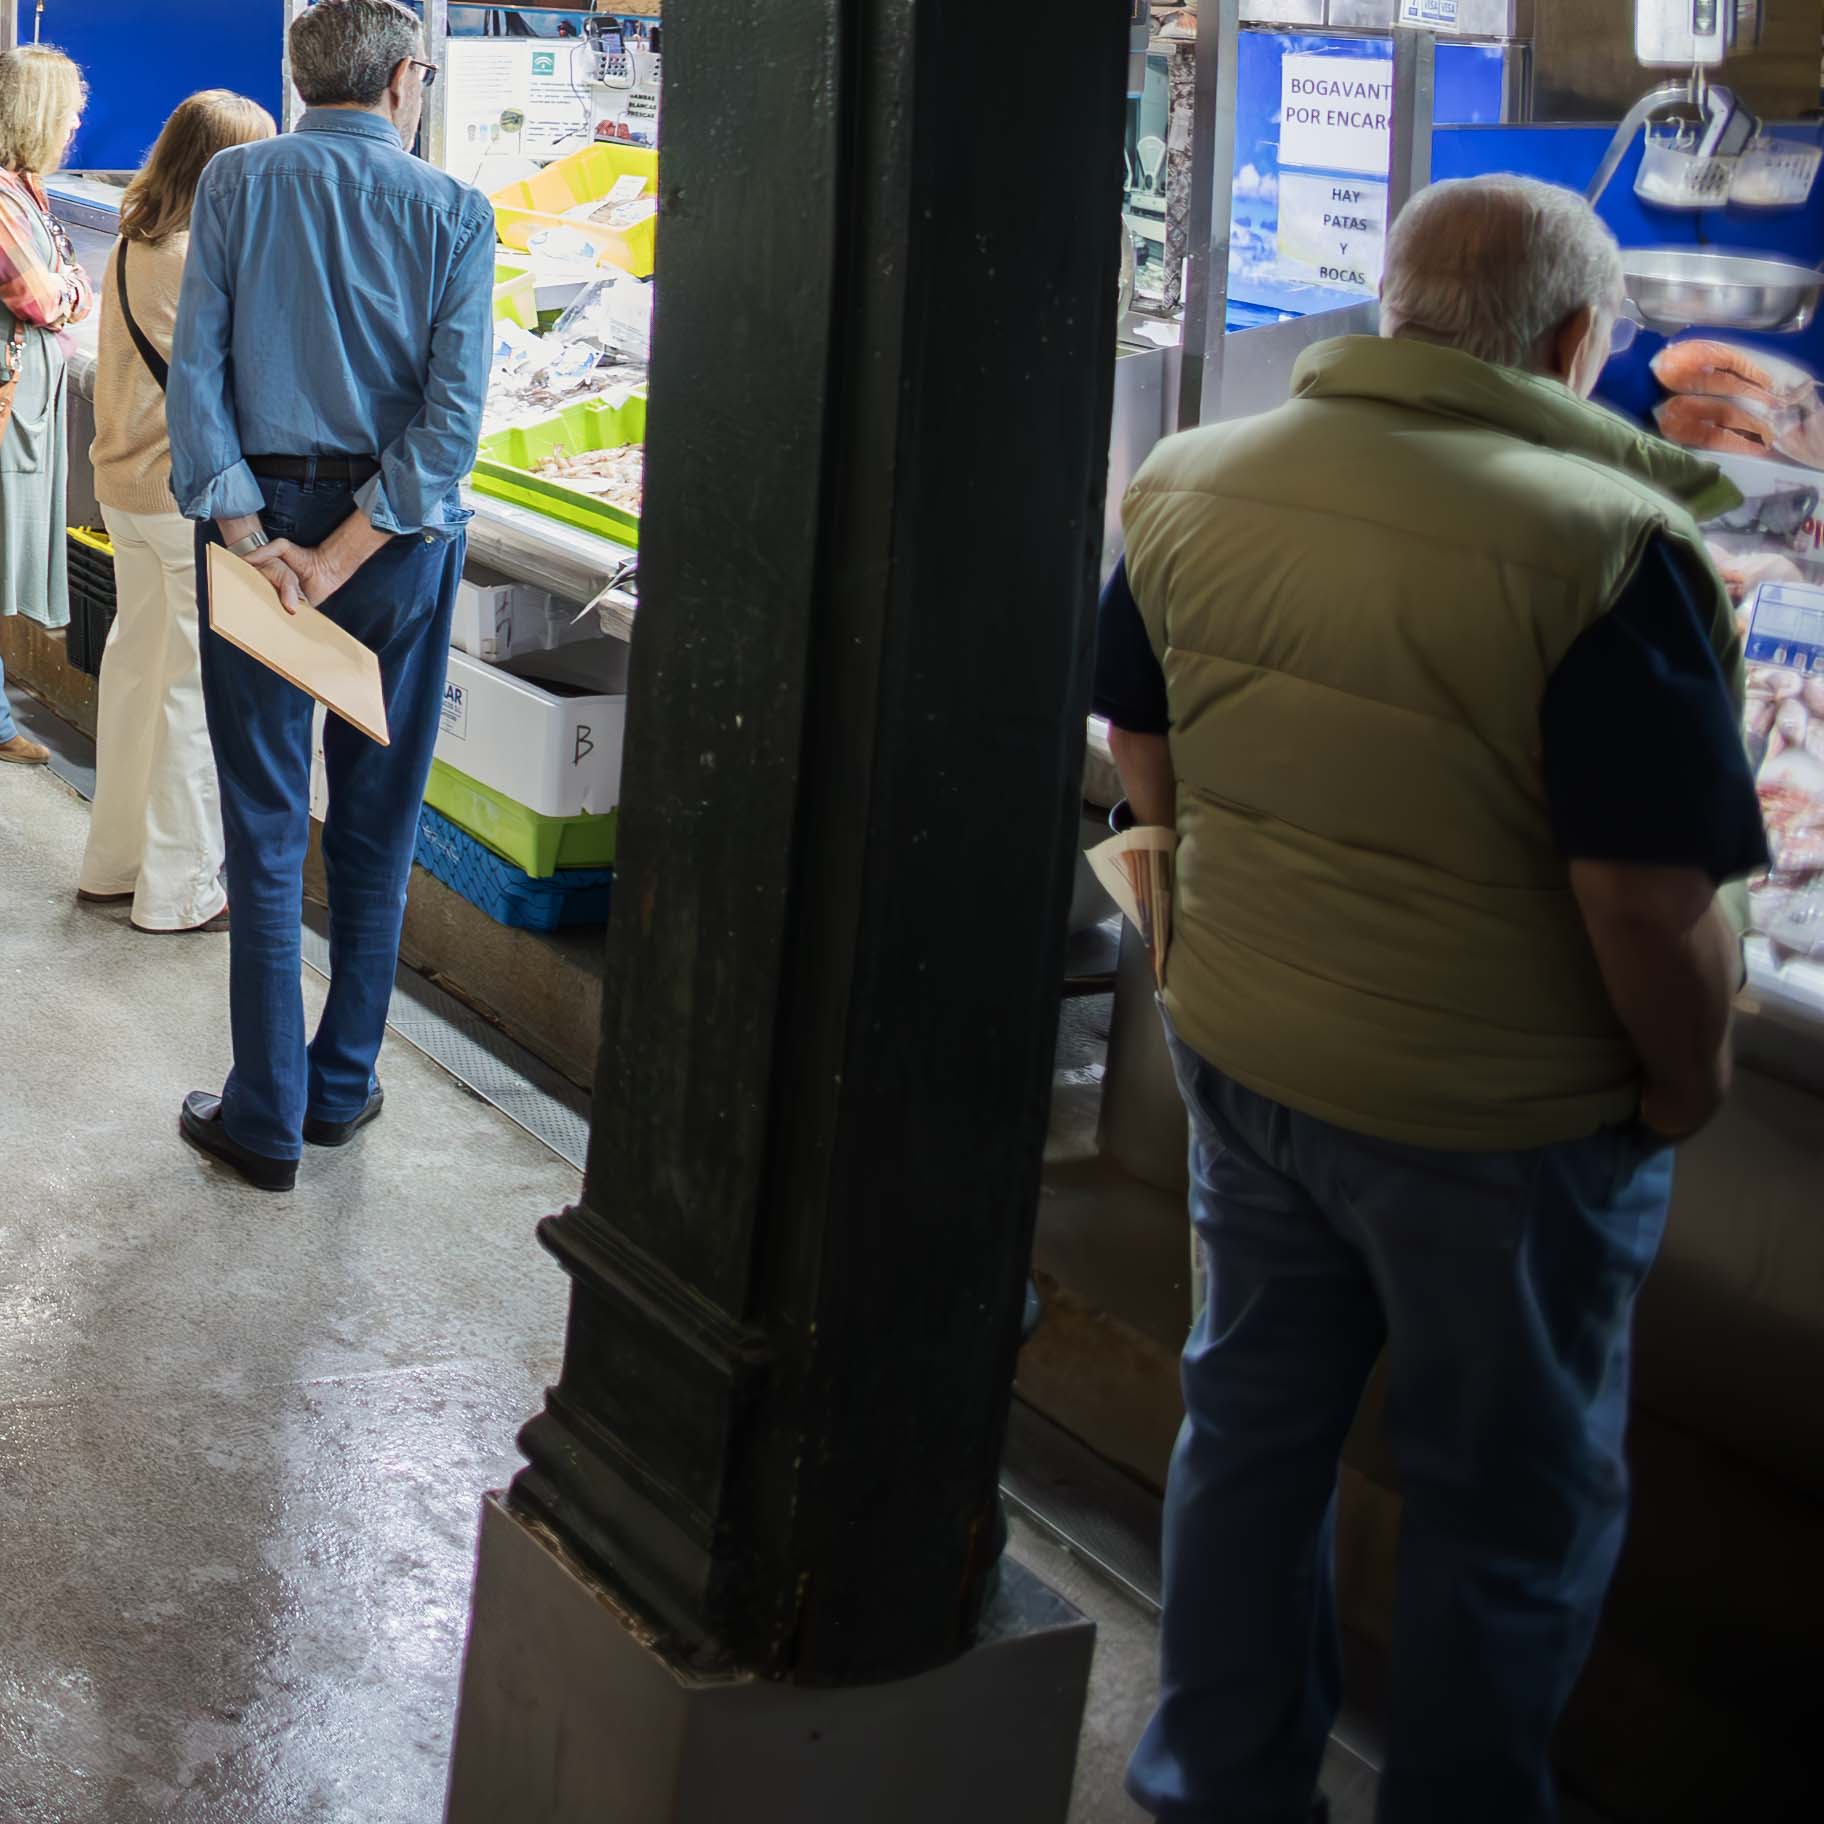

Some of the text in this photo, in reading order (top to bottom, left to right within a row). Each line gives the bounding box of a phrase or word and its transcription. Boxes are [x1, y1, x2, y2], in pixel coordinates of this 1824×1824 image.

[1286, 107, 1393, 130] POR ENCAR
[1332, 187, 1360, 203] HAY
[1323, 214, 1367, 231] PATAS
[1339, 242, 1348, 255] Y
[1320, 266, 1365, 285] BOCAS
[443, 684, 463, 706] AR
[571, 725, 594, 767] B
